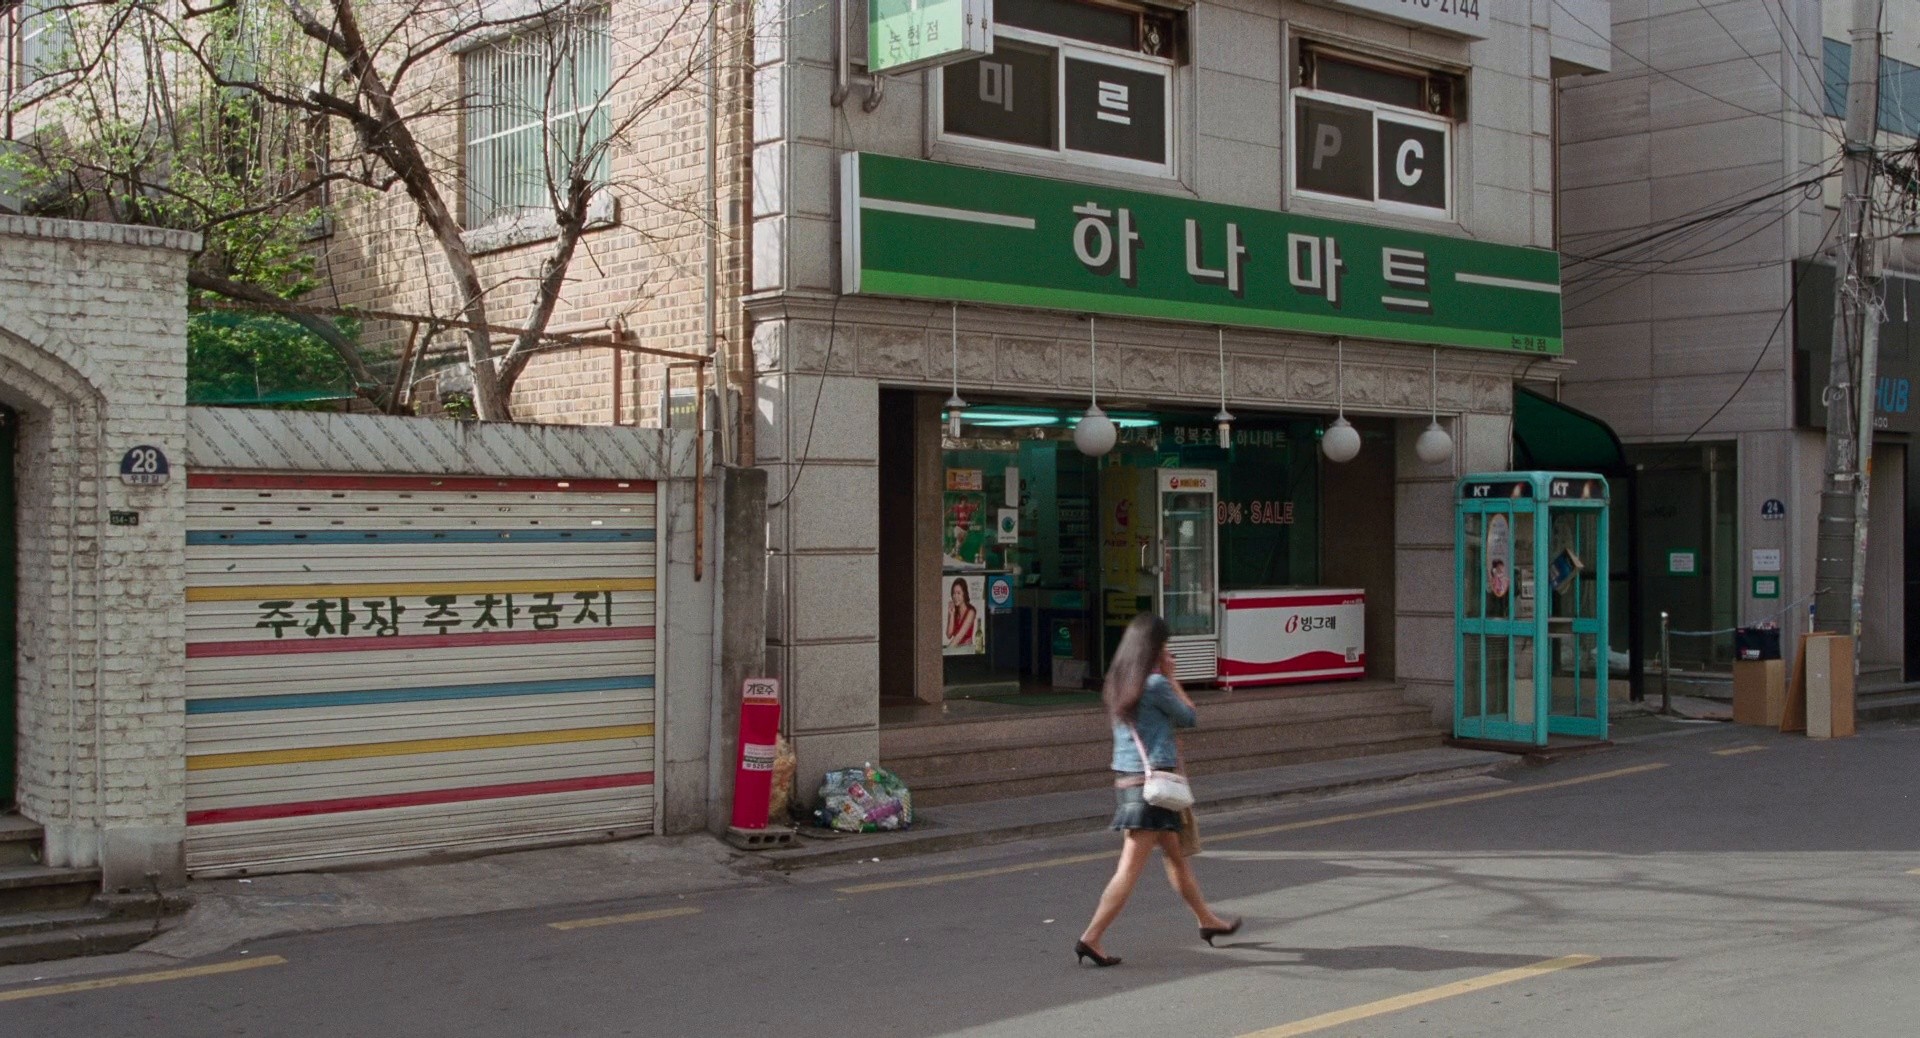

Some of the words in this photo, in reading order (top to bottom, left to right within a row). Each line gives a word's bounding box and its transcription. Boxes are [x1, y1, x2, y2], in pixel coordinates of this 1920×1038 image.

[889, 20, 938, 51] 논현점
[1072, 202, 1433, 311] 하나마트
[131, 449, 158, 473] 28
[1473, 485, 1491, 497] KT
[1553, 482, 1569, 495] KT
[1250, 500, 1294, 524] SALE
[256, 597, 405, 638] 주차장
[423, 590, 613, 636] 주차금지
[1301, 615, 1336, 632] 빙그레
